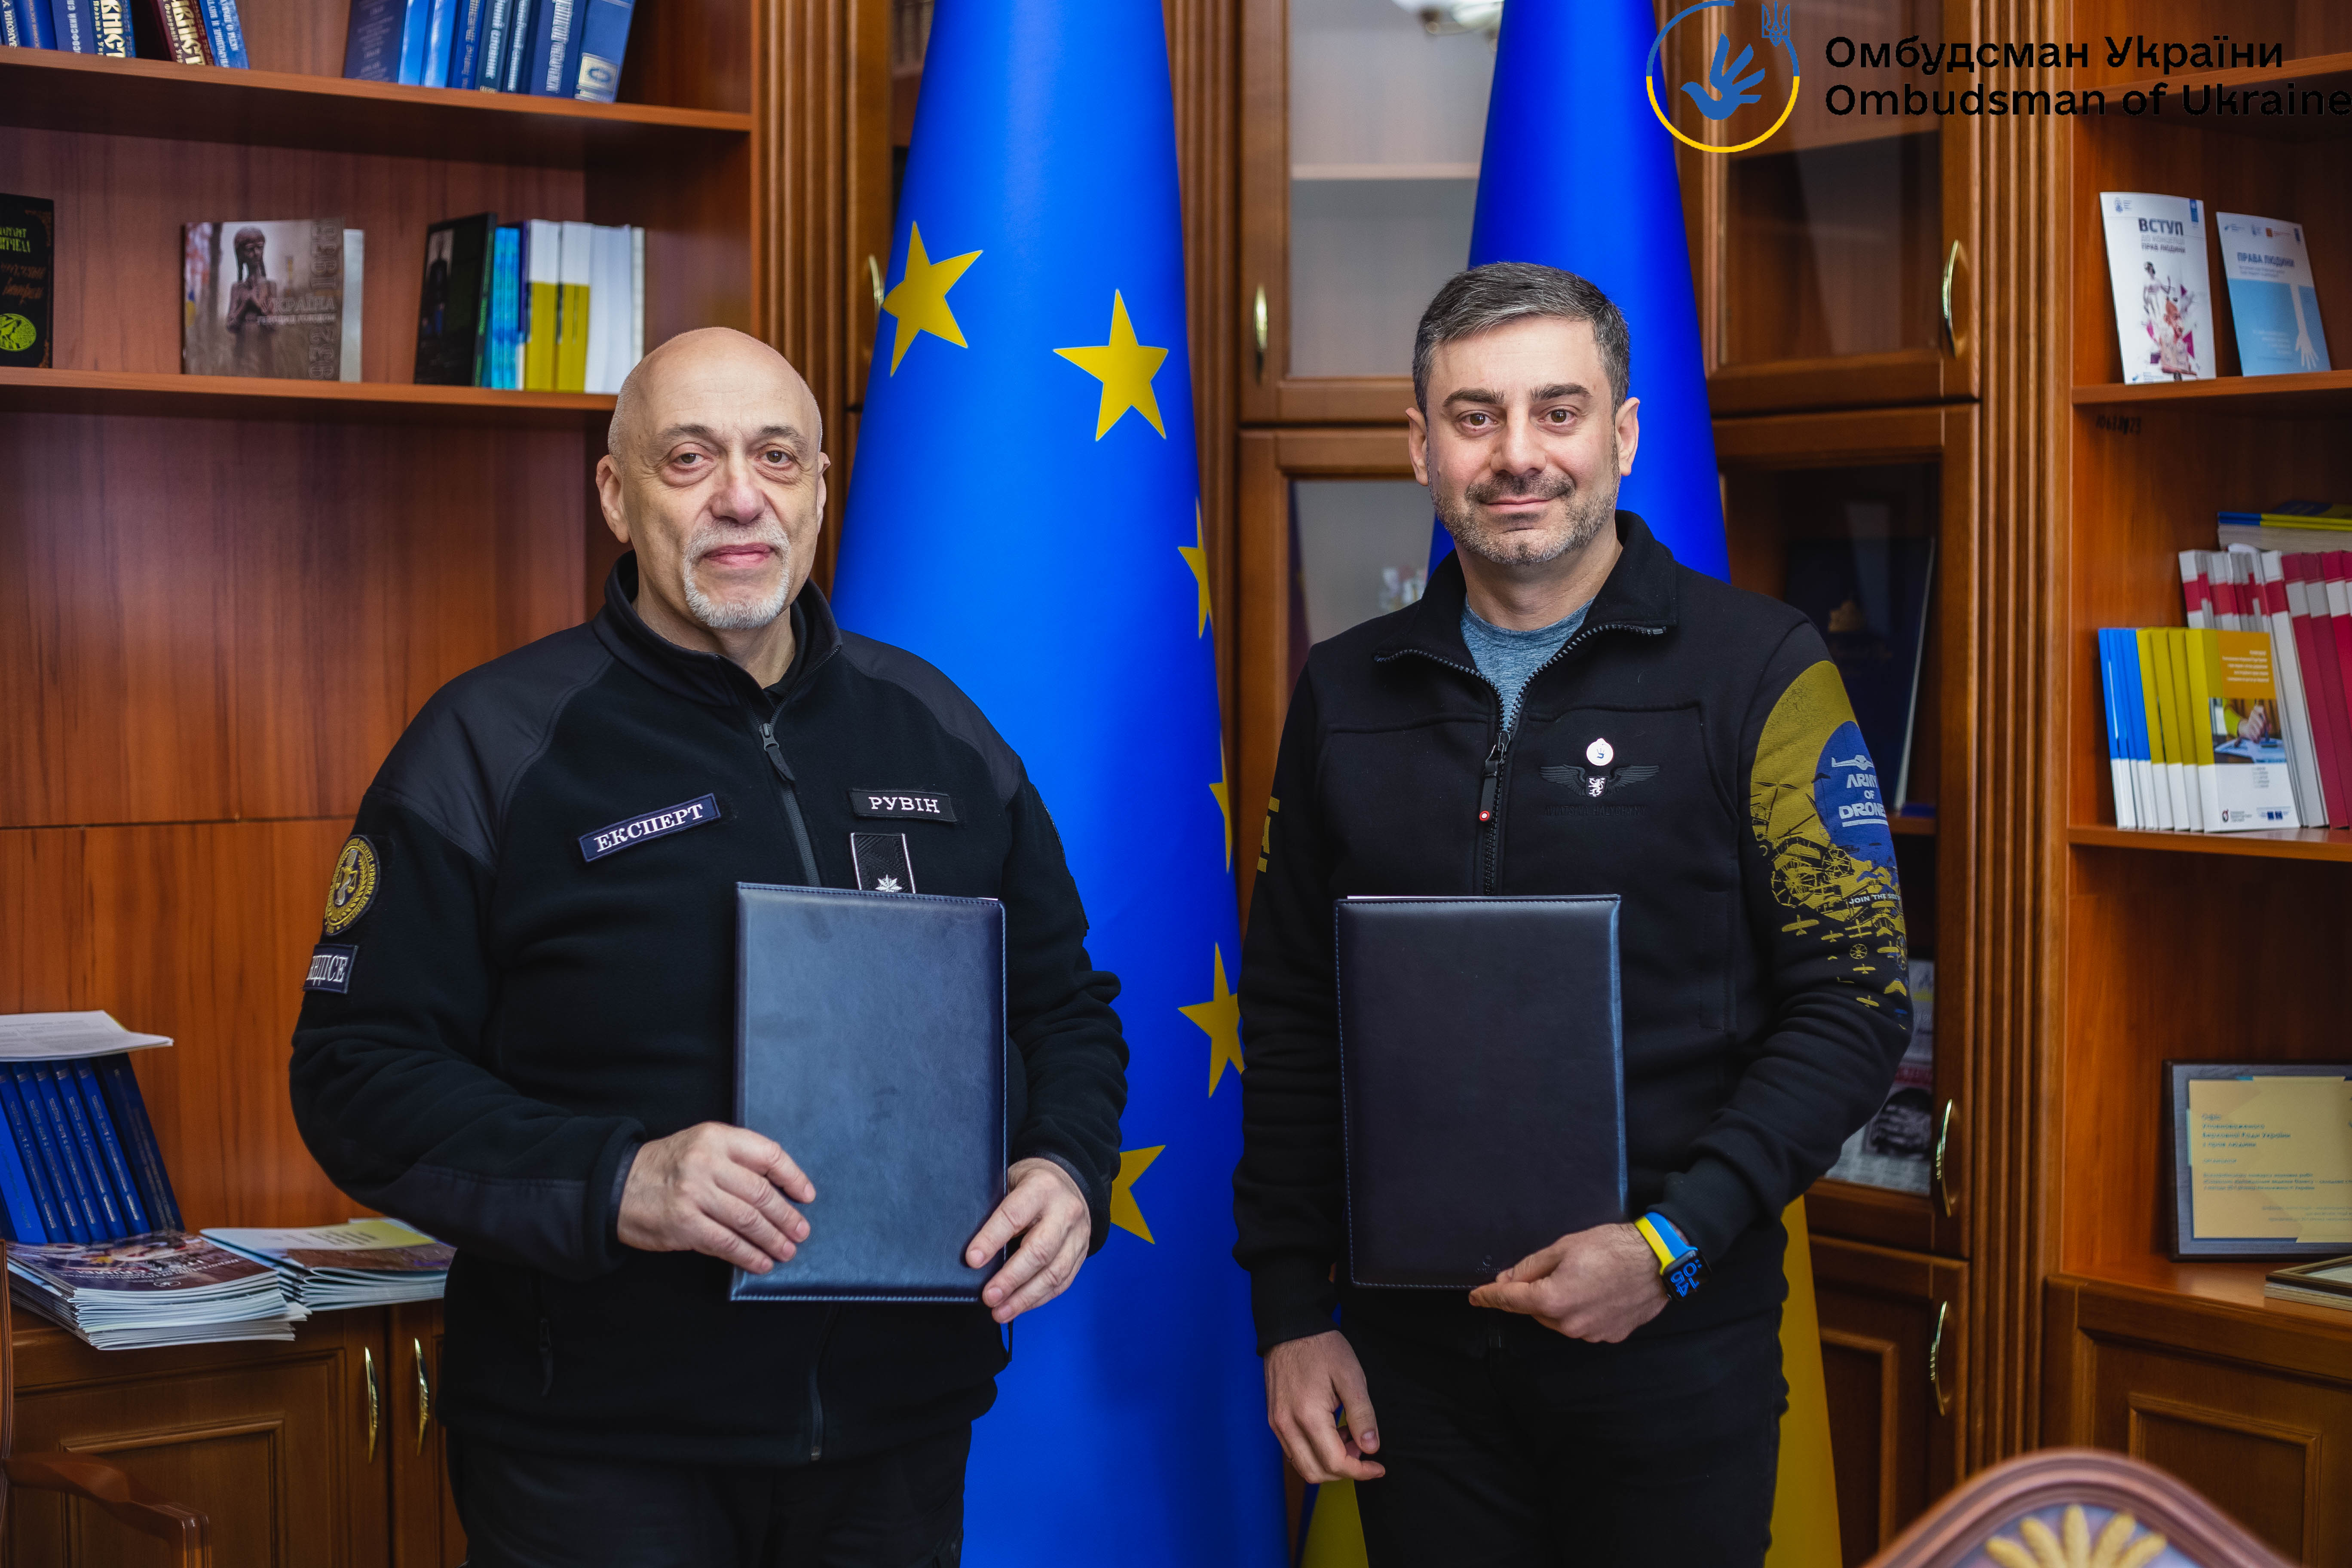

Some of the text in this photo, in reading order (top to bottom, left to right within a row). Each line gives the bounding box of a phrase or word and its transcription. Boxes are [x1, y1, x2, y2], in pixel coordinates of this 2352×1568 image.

[3, 10, 18, 49] ЗАКОНИ
[2139, 217, 2183, 236] ВСТУП
[1847, 774, 1877, 788] ARMY
[1864, 790, 1874, 799] OF
[869, 796, 941, 814] РУВІН
[593, 803, 704, 853] ЕКСПЕРТ
[1849, 896, 1870, 904] JOIN
